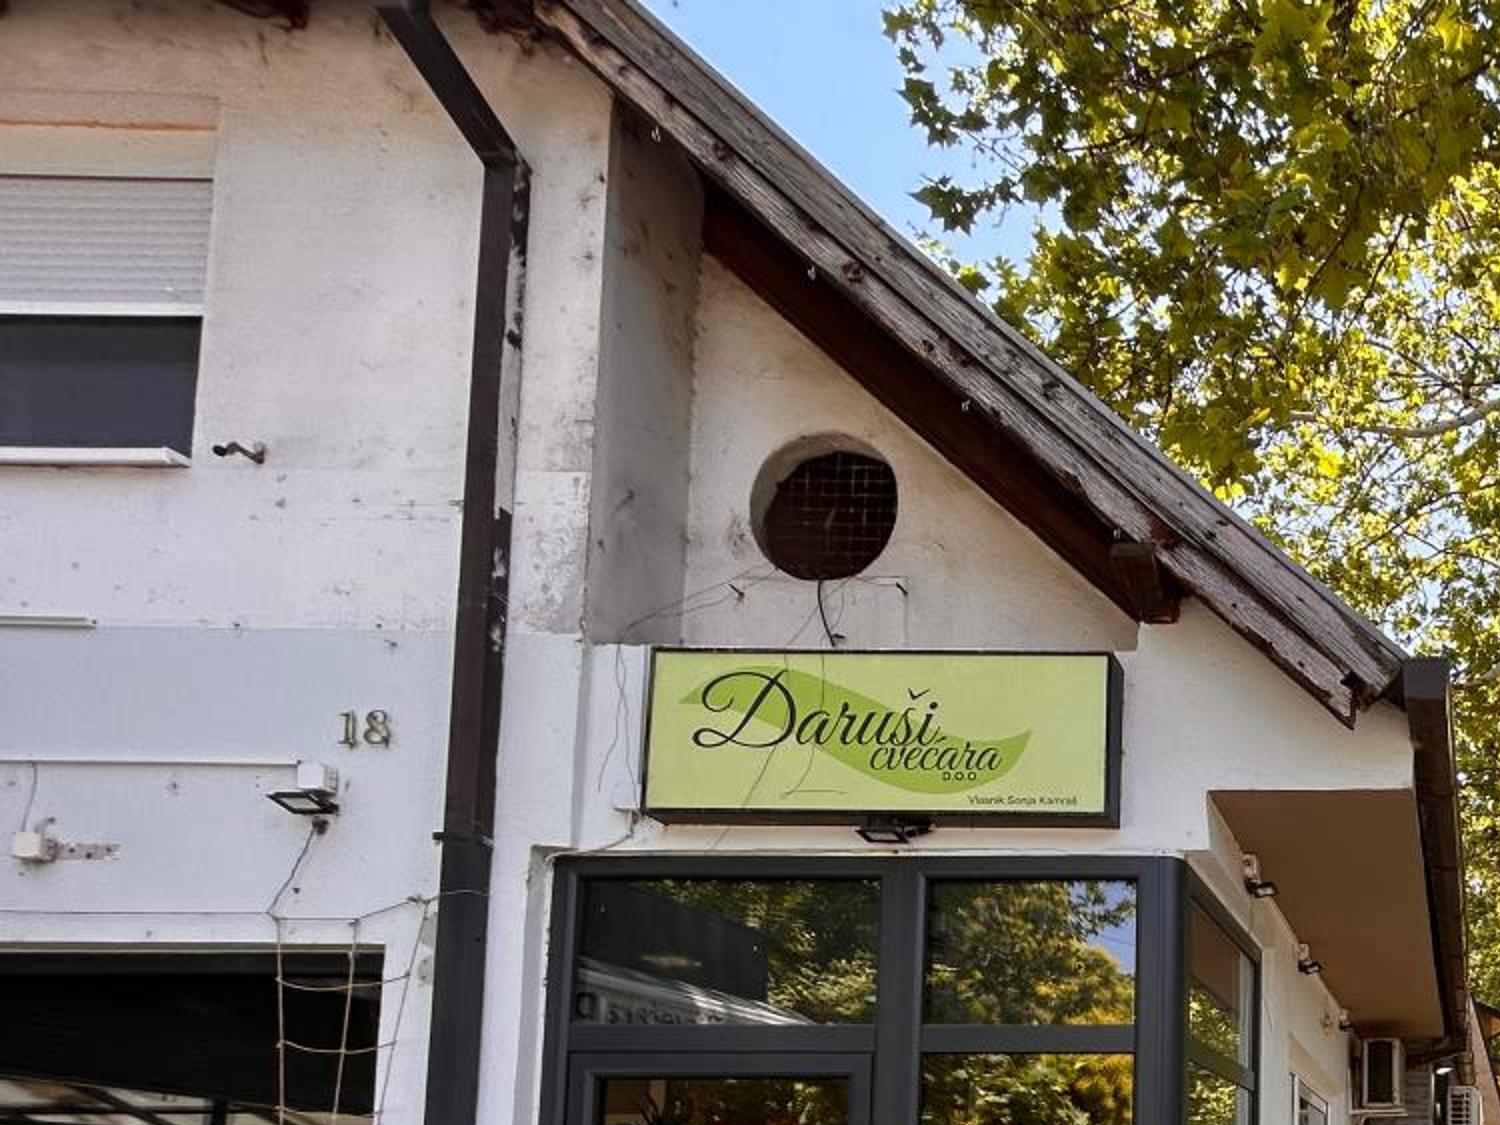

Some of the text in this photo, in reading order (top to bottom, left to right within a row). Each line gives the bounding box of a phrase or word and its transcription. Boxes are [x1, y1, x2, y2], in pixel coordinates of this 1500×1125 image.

[692, 669, 940, 748] Daruši
[337, 709, 391, 749] 18
[870, 735, 1002, 770] cvećara
